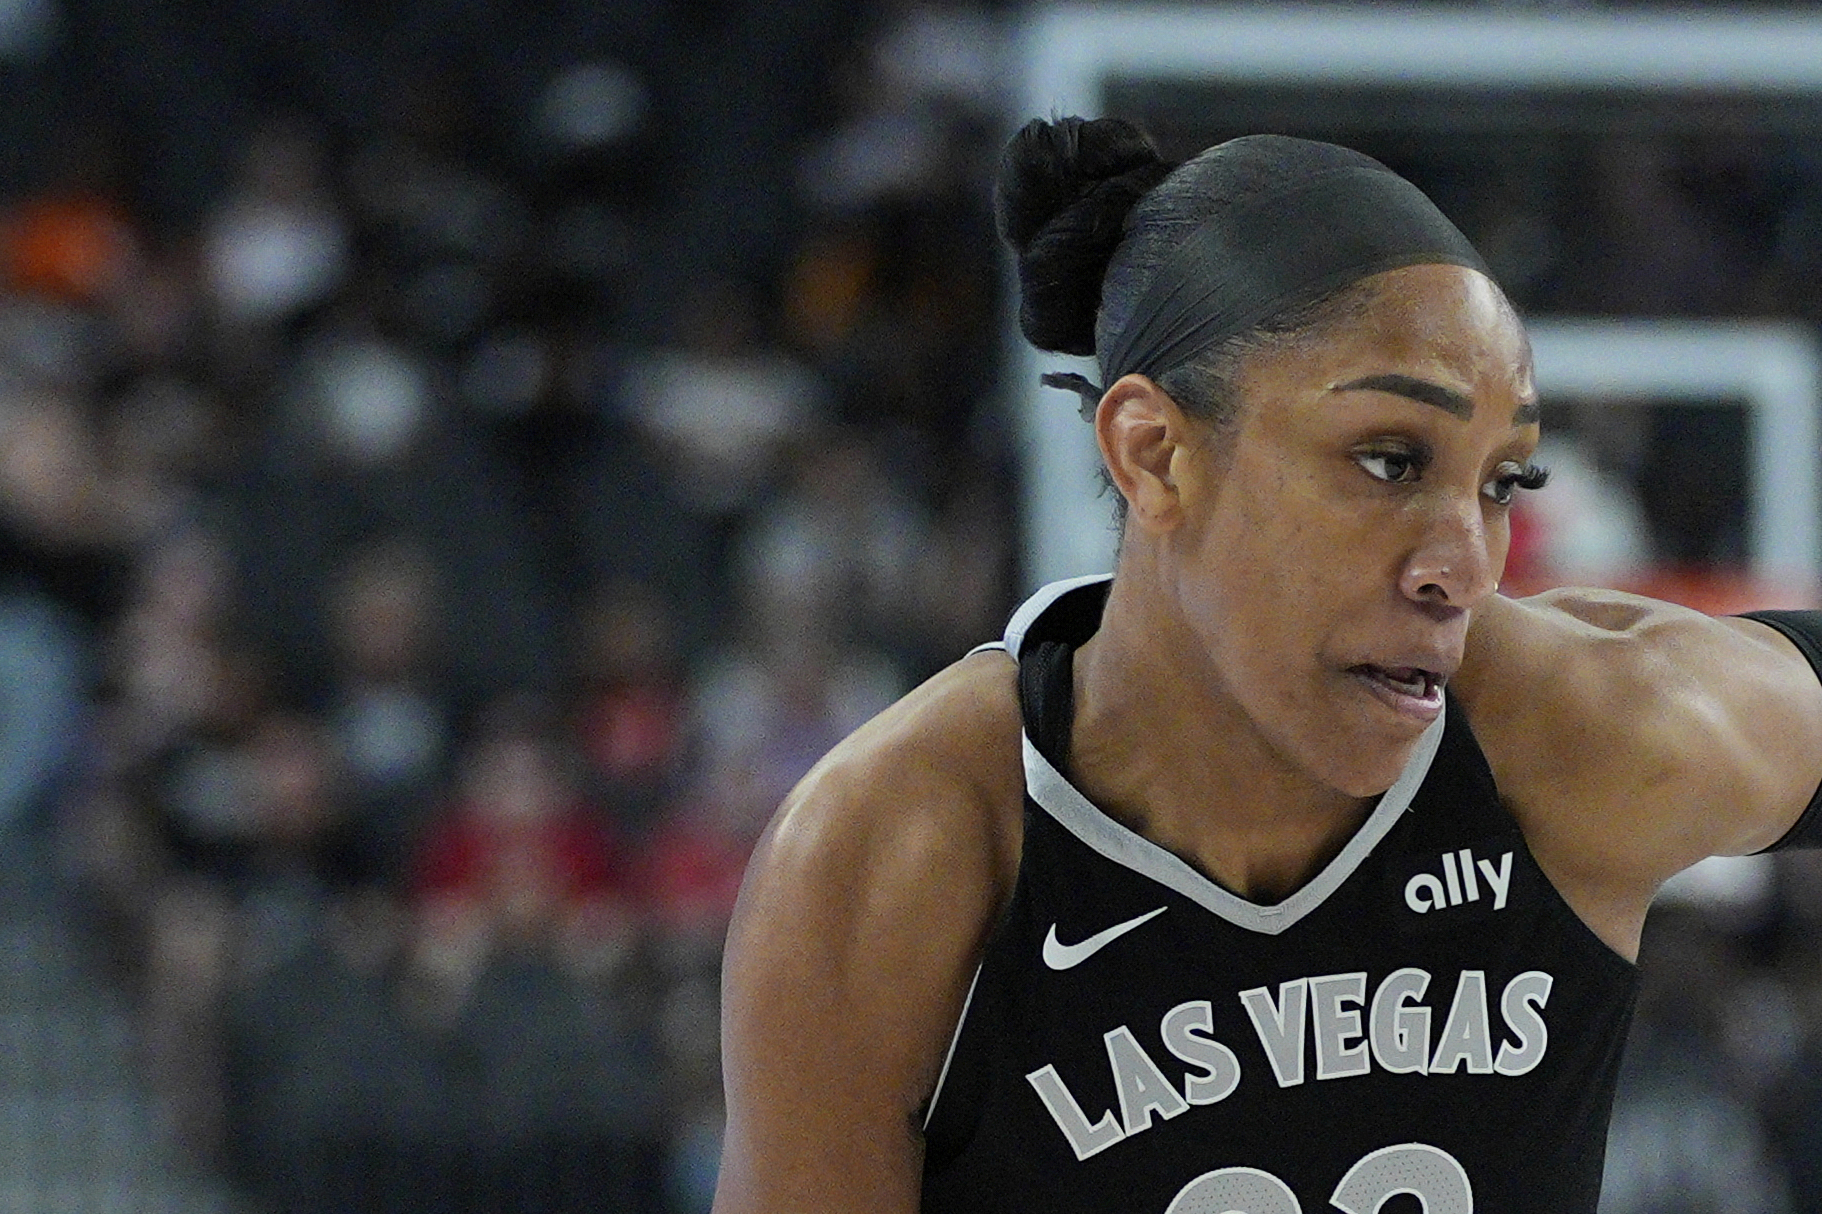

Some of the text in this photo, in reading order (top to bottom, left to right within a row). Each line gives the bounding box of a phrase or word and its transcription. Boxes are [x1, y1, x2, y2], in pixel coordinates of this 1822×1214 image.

[1404, 848, 1514, 914] ally
[1025, 967, 1554, 1161] LAS VEGAS
